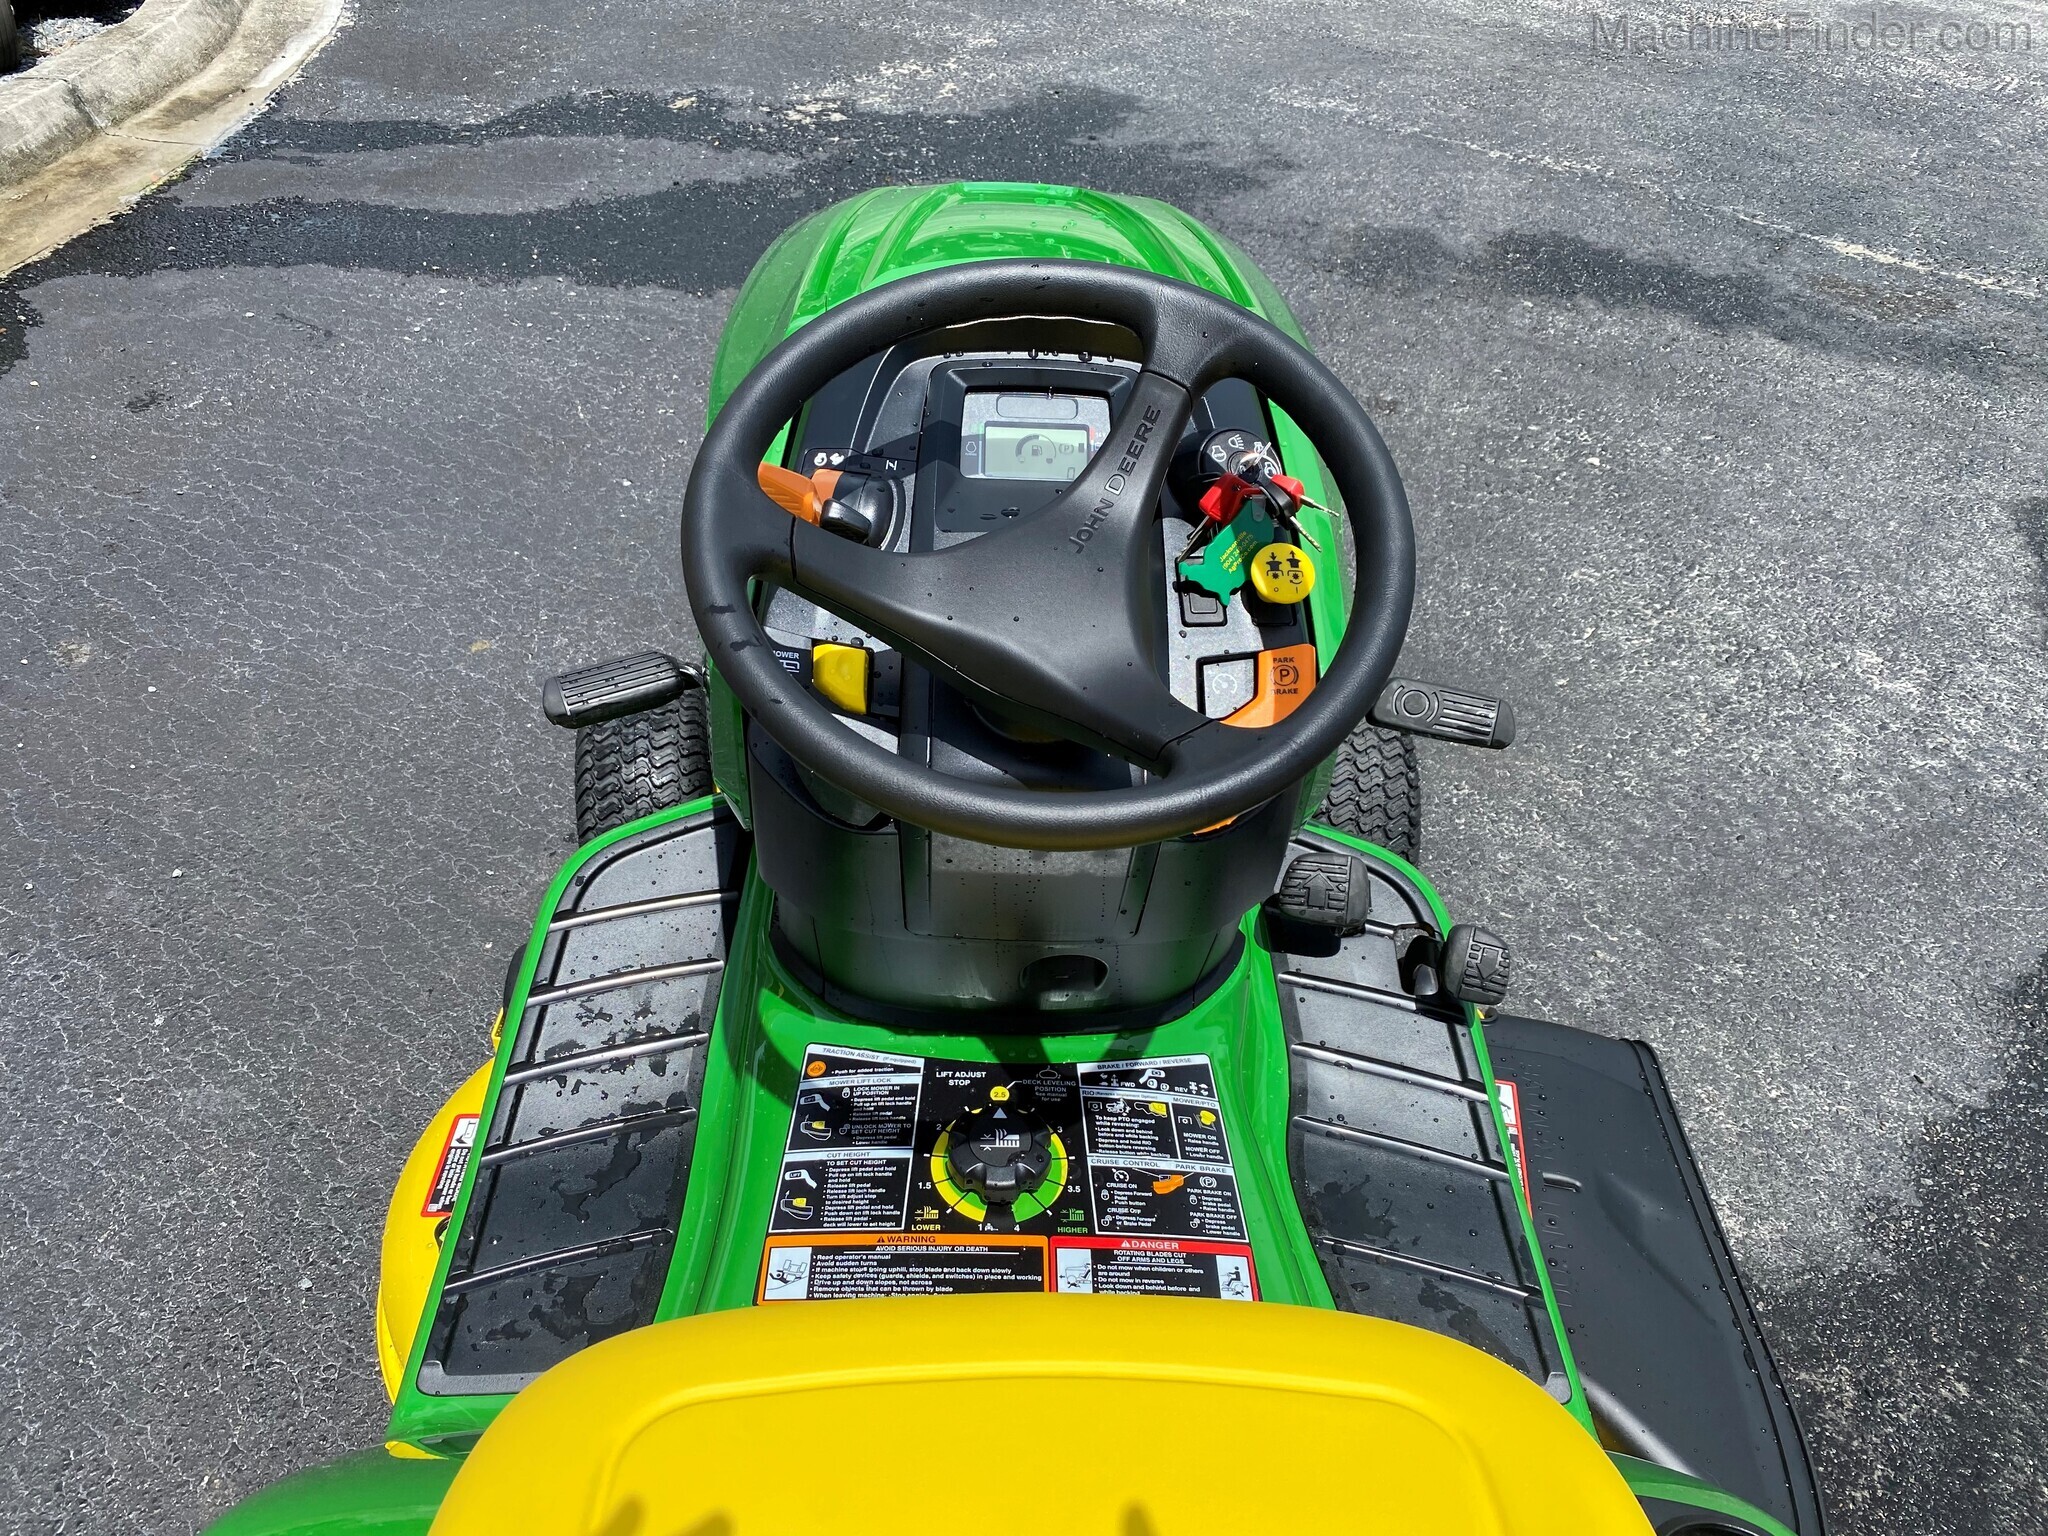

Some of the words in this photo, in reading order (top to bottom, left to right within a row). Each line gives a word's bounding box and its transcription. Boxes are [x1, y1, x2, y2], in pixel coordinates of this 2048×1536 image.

[1069, 498, 1114, 554] JOHN
[1104, 405, 1161, 495] DEERE
[1219, 531, 1247, 562] Jacksonville
[1228, 540, 1258, 574] AgProCo.com
[773, 650, 799, 659] OWER
[1280, 669, 1290, 682] P
[823, 1048, 854, 1056] TRACTION
[1173, 1097, 1215, 1107] MOWER/PTO
[1130, 1240, 1179, 1249] DANGER
